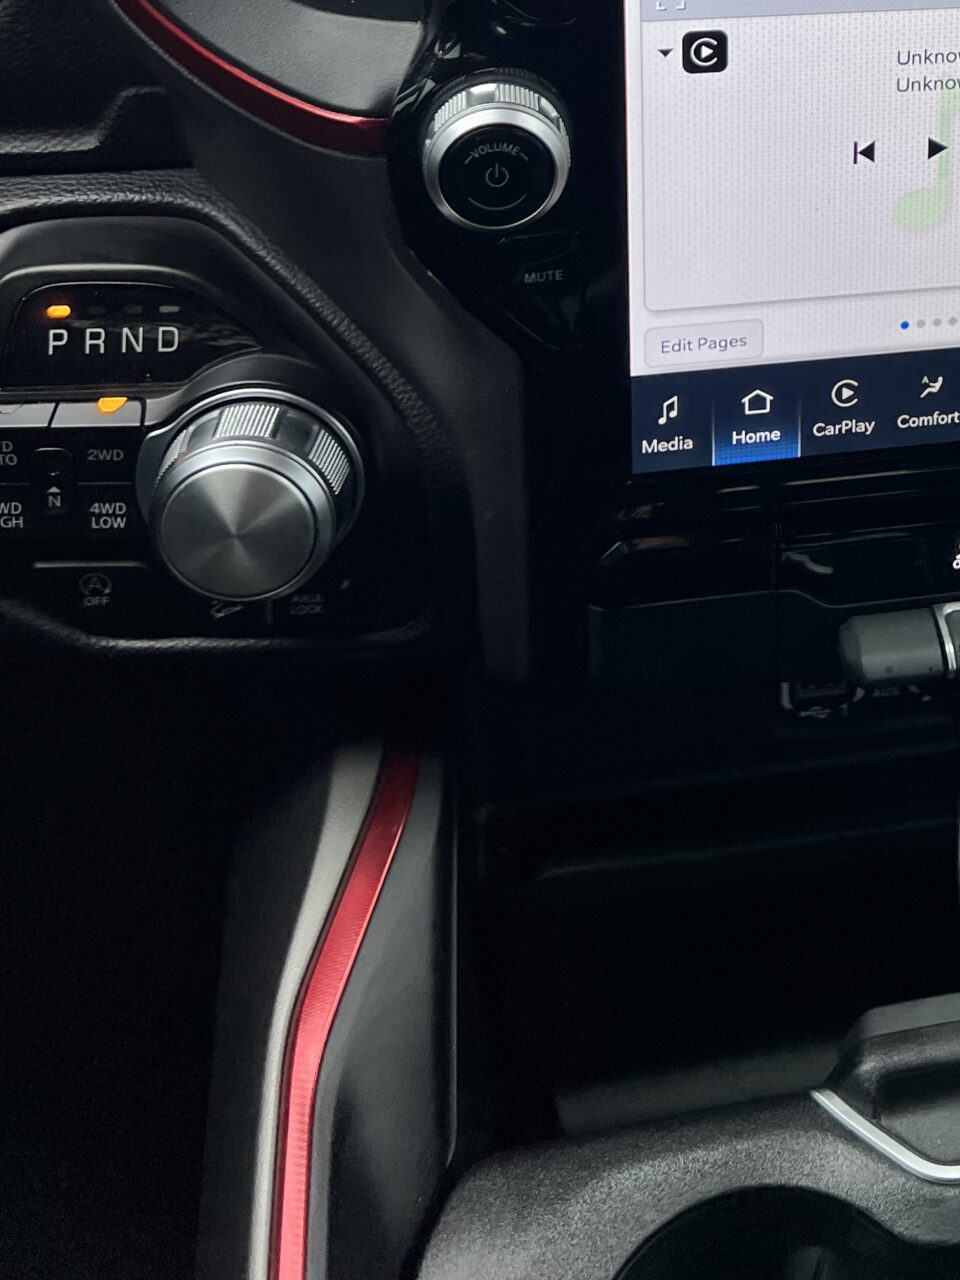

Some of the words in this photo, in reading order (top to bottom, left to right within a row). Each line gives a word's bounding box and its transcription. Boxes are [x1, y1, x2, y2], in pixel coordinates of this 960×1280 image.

[470, 143, 521, 159] VOLUME
[524, 270, 564, 283] MUTE
[48, 329, 69, 355] P
[84, 328, 106, 354] R
[121, 327, 144, 353] N
[157, 326, 180, 352] D
[661, 338, 693, 354] Edit
[698, 334, 748, 352] Pages
[813, 418, 876, 437] CarPlay
[897, 410, 960, 430] Comfort
[641, 435, 694, 455] Media
[732, 428, 781, 446] Home
[87, 449, 124, 461] 2WD
[48, 495, 62, 507] N
[89, 502, 127, 515] 4WD
[91, 516, 127, 529] LOW
